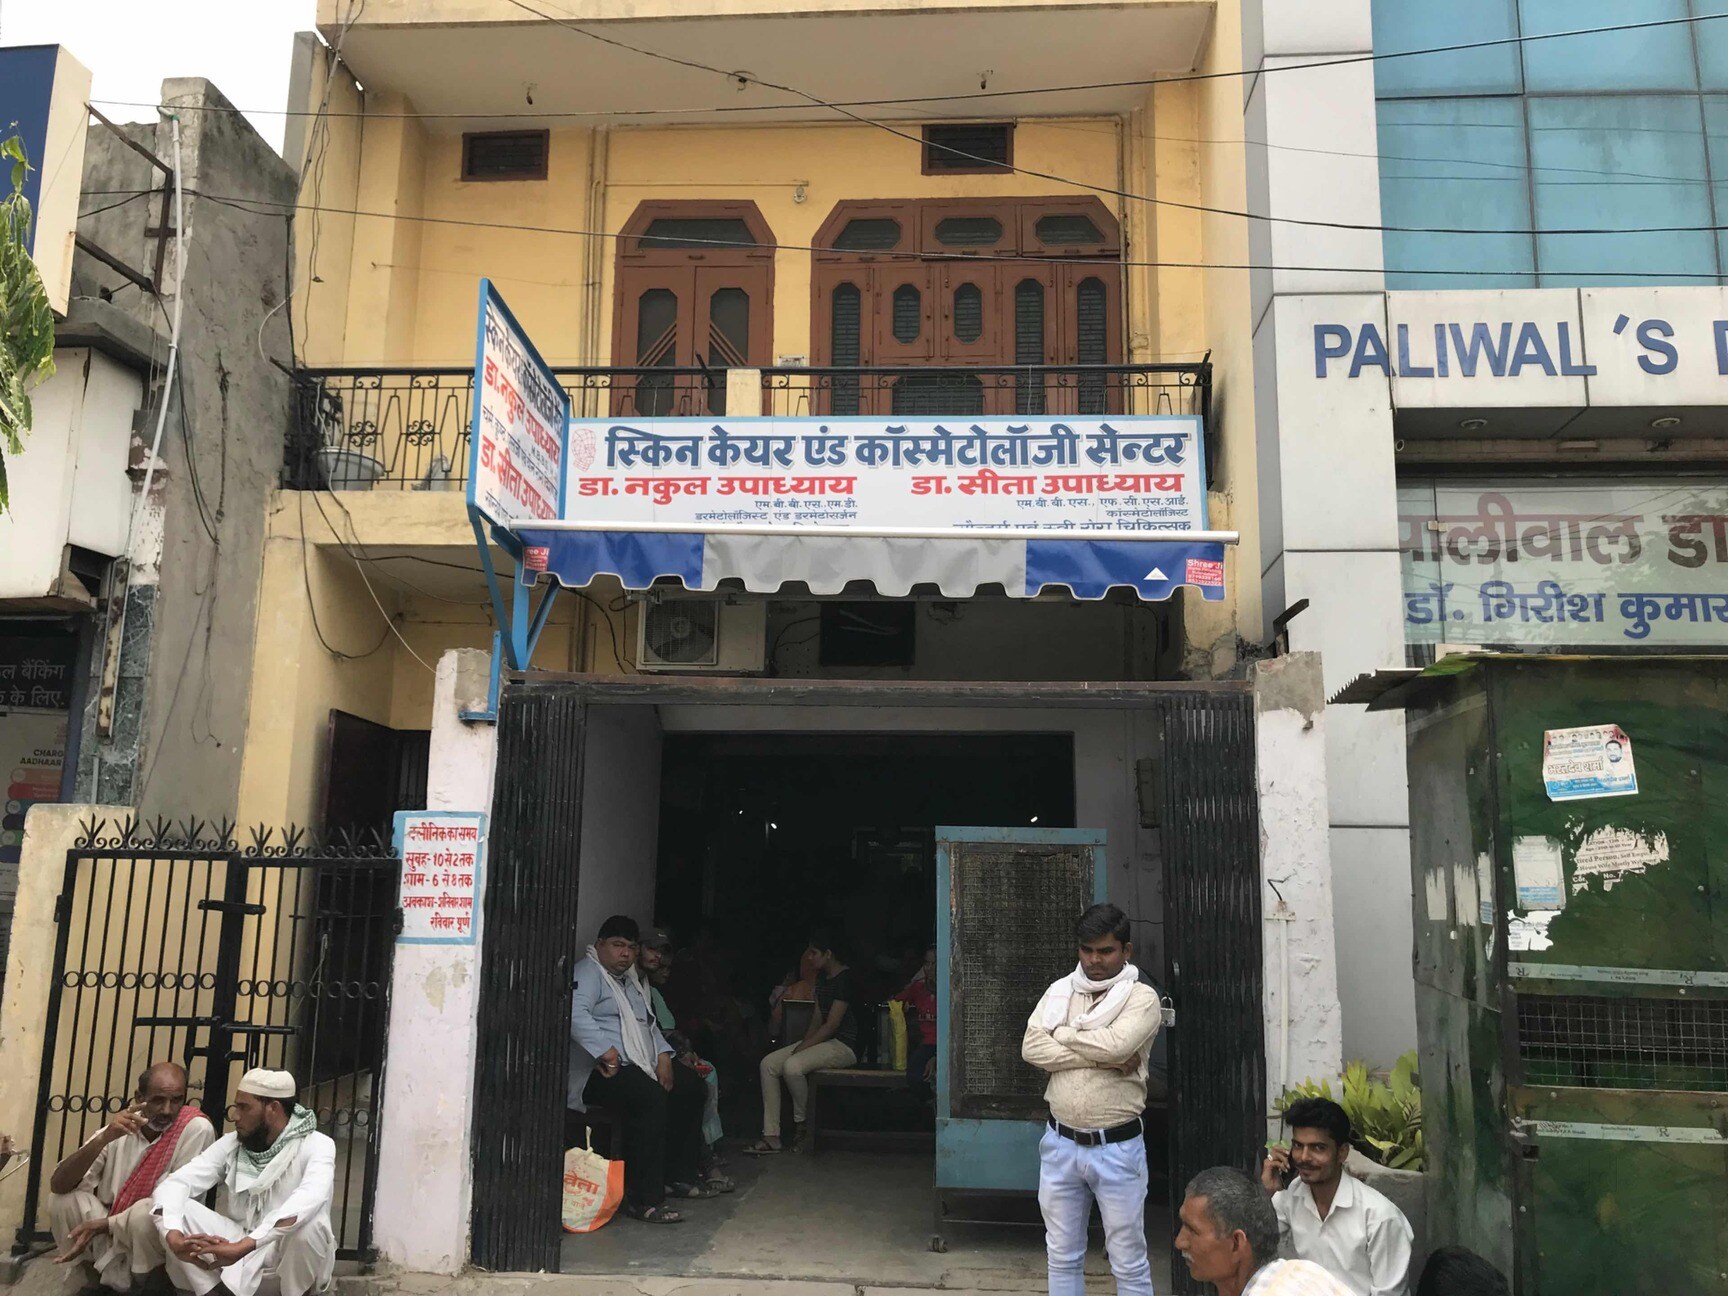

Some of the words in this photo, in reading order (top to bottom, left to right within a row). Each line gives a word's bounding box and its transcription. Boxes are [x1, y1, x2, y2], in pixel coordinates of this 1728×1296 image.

[501, 373, 525, 425] नकुल
[525, 408, 560, 465] उपाध्याय
[605, 425, 704, 467] स्किन
[709, 425, 798, 467] केयर
[801, 426, 849, 465] एंड
[854, 424, 1081, 466] कॉस्मेटोलॉजी
[1085, 423, 1188, 464] सेन्टर
[497, 447, 522, 500] सीता
[911, 475, 951, 495] डा.
[958, 469, 1037, 495] सीता
[1041, 473, 1185, 495] उपाध्याय
[578, 477, 619, 496] डा.
[625, 477, 711, 504] नकुल
[716, 477, 857, 496] उपाध्याय
[773, 510, 791, 521] एंड
[1404, 582, 1465, 625] डॉ.
[1478, 580, 1605, 624] गिरीश
[21, 658, 66, 680] बैंकिंग
[10, 684, 26, 706] के
[447, 827, 459, 841] का
[433, 853, 444, 867] 10
[445, 847, 453, 866] से
[453, 853, 459, 866] 2
[460, 853, 474, 866] तक
[432, 873, 439, 887] 6
[442, 869, 450, 886] से
[451, 873, 457, 886] 8
[458, 873, 473, 888] तक
